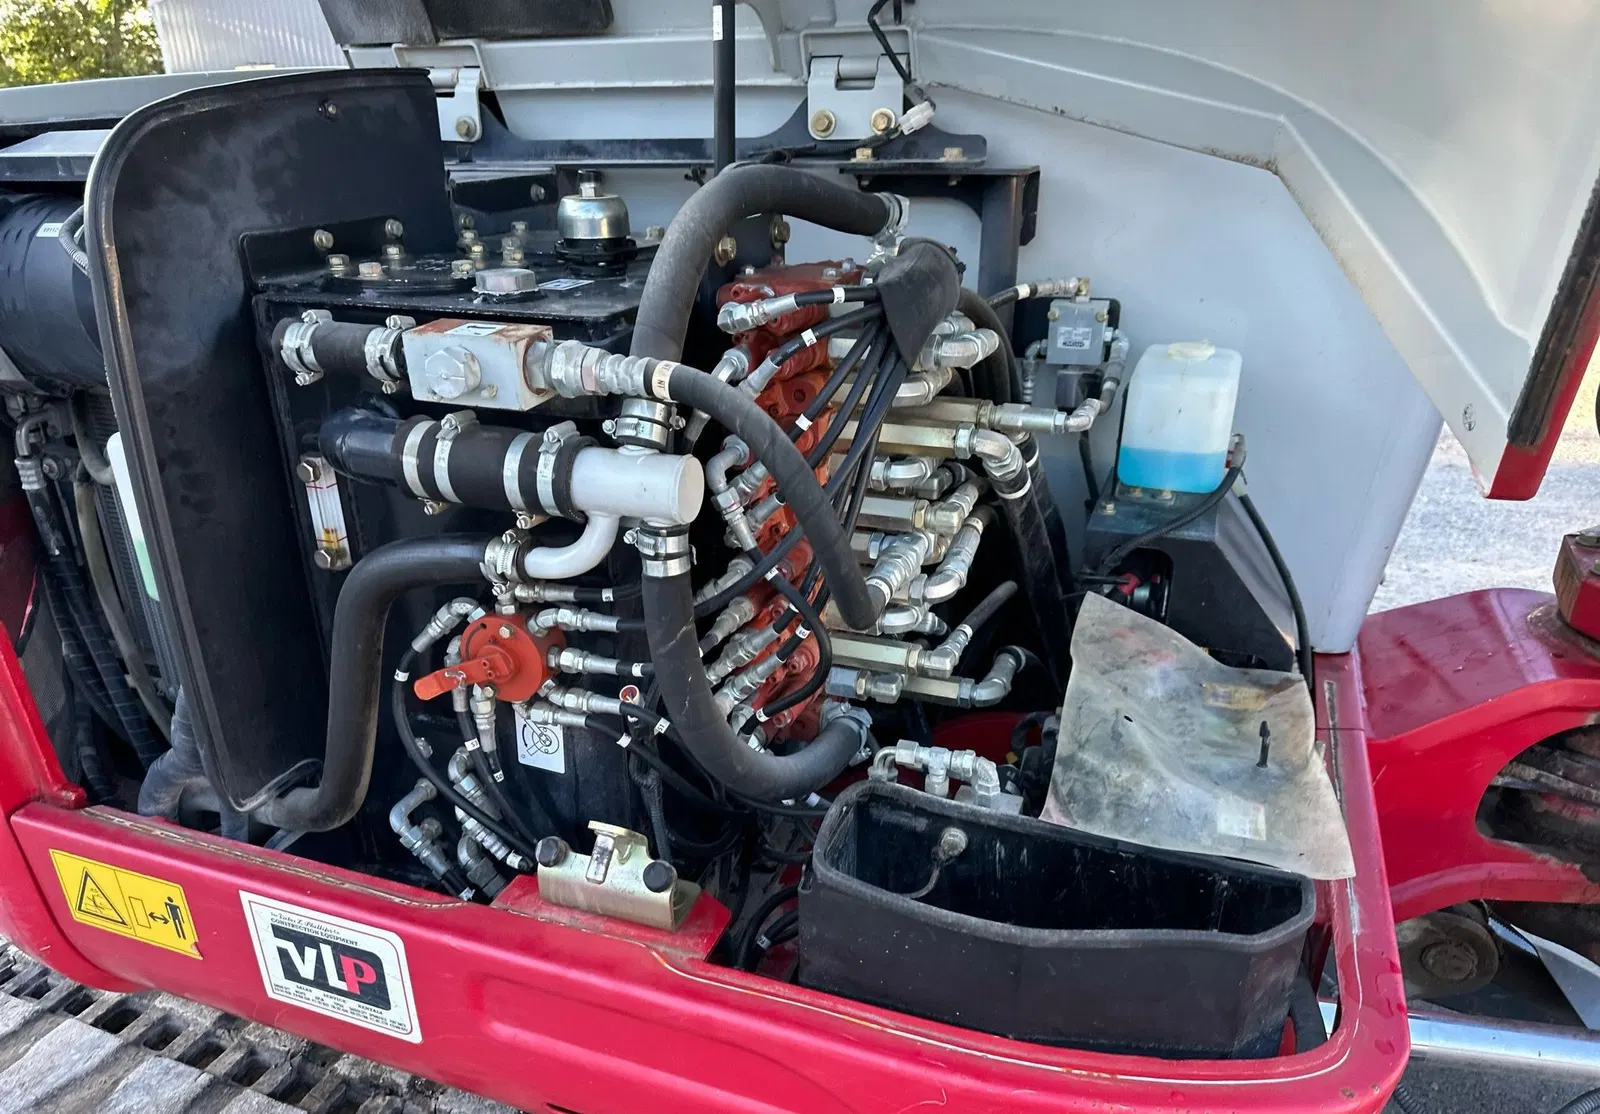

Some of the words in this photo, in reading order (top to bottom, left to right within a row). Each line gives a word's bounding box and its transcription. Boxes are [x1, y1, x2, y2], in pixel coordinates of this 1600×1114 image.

[270, 917, 320, 936] CONSTRUCTION
[320, 930, 359, 947] EQUIPMENT
[274, 936, 377, 995] VLP
